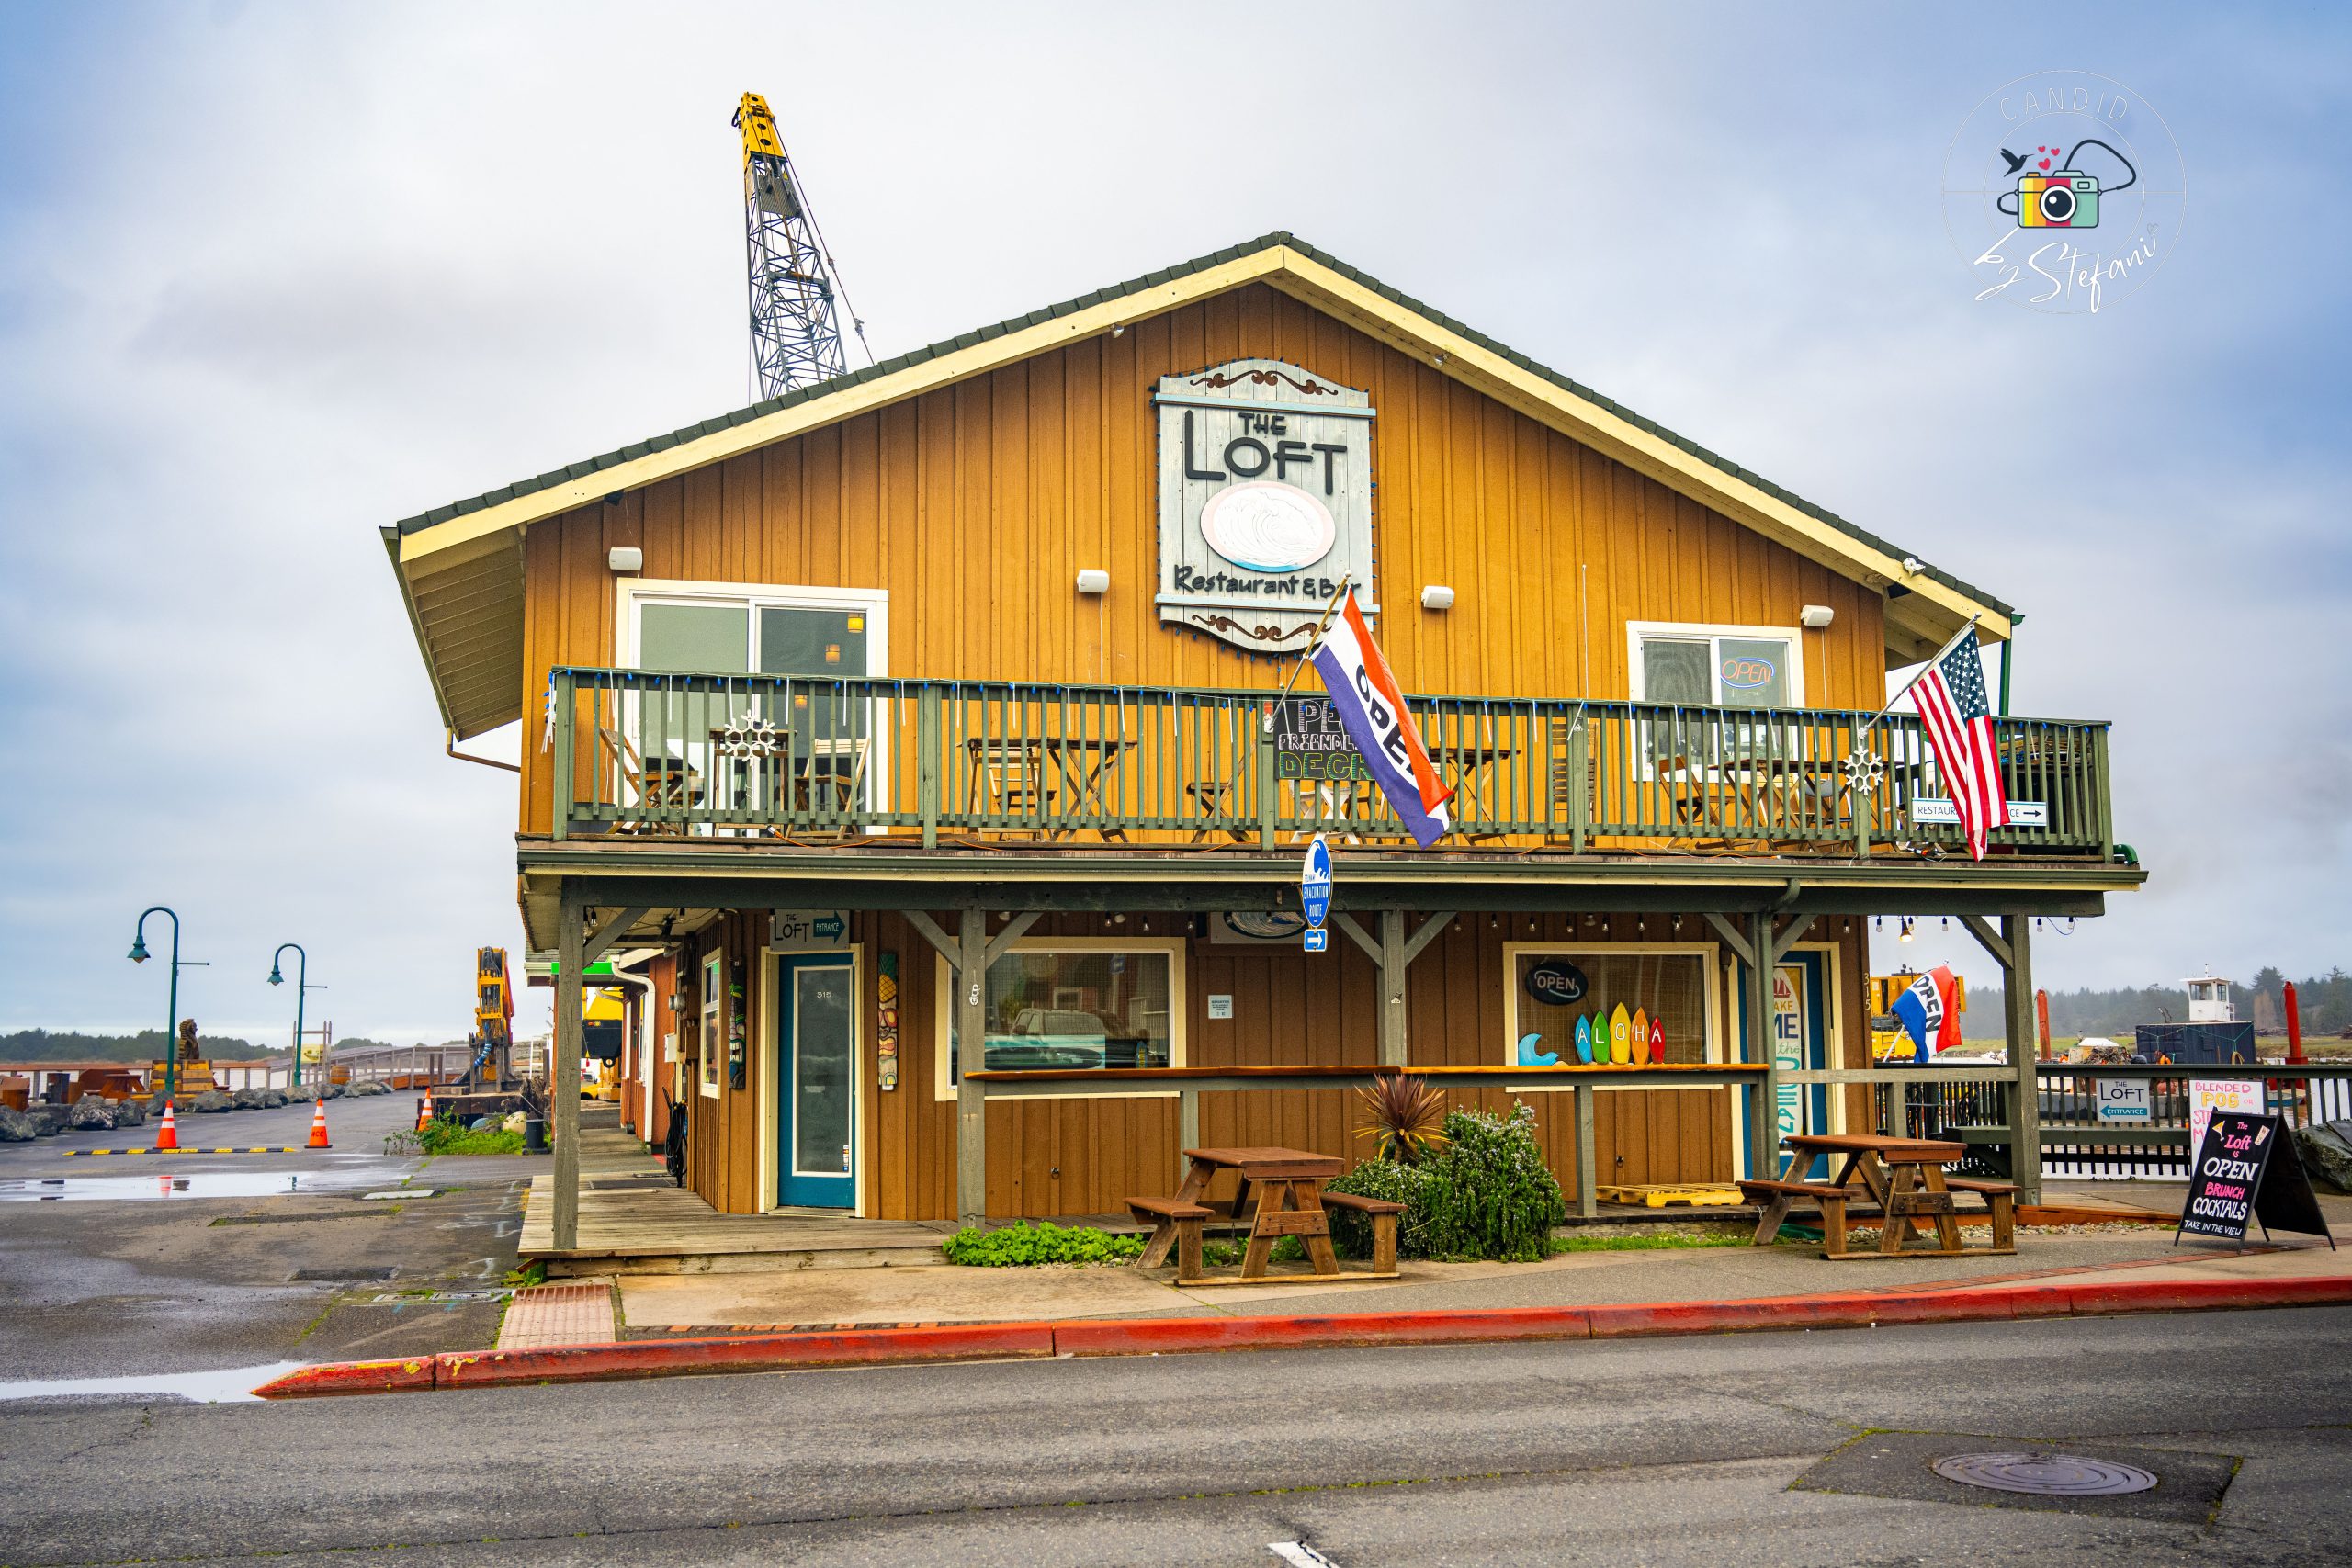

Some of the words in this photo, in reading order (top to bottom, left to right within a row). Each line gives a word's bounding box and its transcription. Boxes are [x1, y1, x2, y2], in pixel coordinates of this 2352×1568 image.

[1238, 412, 1287, 435] THE
[1184, 410, 1348, 495] LOFT
[1174, 565, 1299, 593] Restaurant
[1721, 660, 1772, 682] OPEN
[1297, 699, 1341, 733] PE
[1355, 664, 1415, 776] OPE
[1278, 733, 1359, 751] FRIENDL
[1279, 751, 1376, 781] DECK
[1917, 806, 1958, 816] RESTAUR
[774, 916, 809, 942] LOFT
[816, 922, 840, 932] ENTRANCE
[1536, 976, 1576, 990] OPEN
[1774, 1000, 1793, 1010] AKE
[1913, 976, 1942, 1033] OPEN
[1577, 1022, 1662, 1044] ALOHA
[2100, 1082, 2144, 1102] LOFT
[2195, 1081, 2252, 1093] BLENDED
[2201, 1092, 2239, 1108] POG
[2237, 1122, 2248, 1130] The
[2224, 1134, 2252, 1150] Loft
[2203, 1157, 2259, 1181] OPEN
[2204, 1182, 2245, 1200] BRUNCH
[2192, 1197, 2248, 1221] COCKTAILS
[2184, 1219, 2199, 1230] TAKE
[2202, 1222, 2211, 1231] IN
[2211, 1224, 2223, 1234] THE
[2224, 1225, 2243, 1235] VIEW
